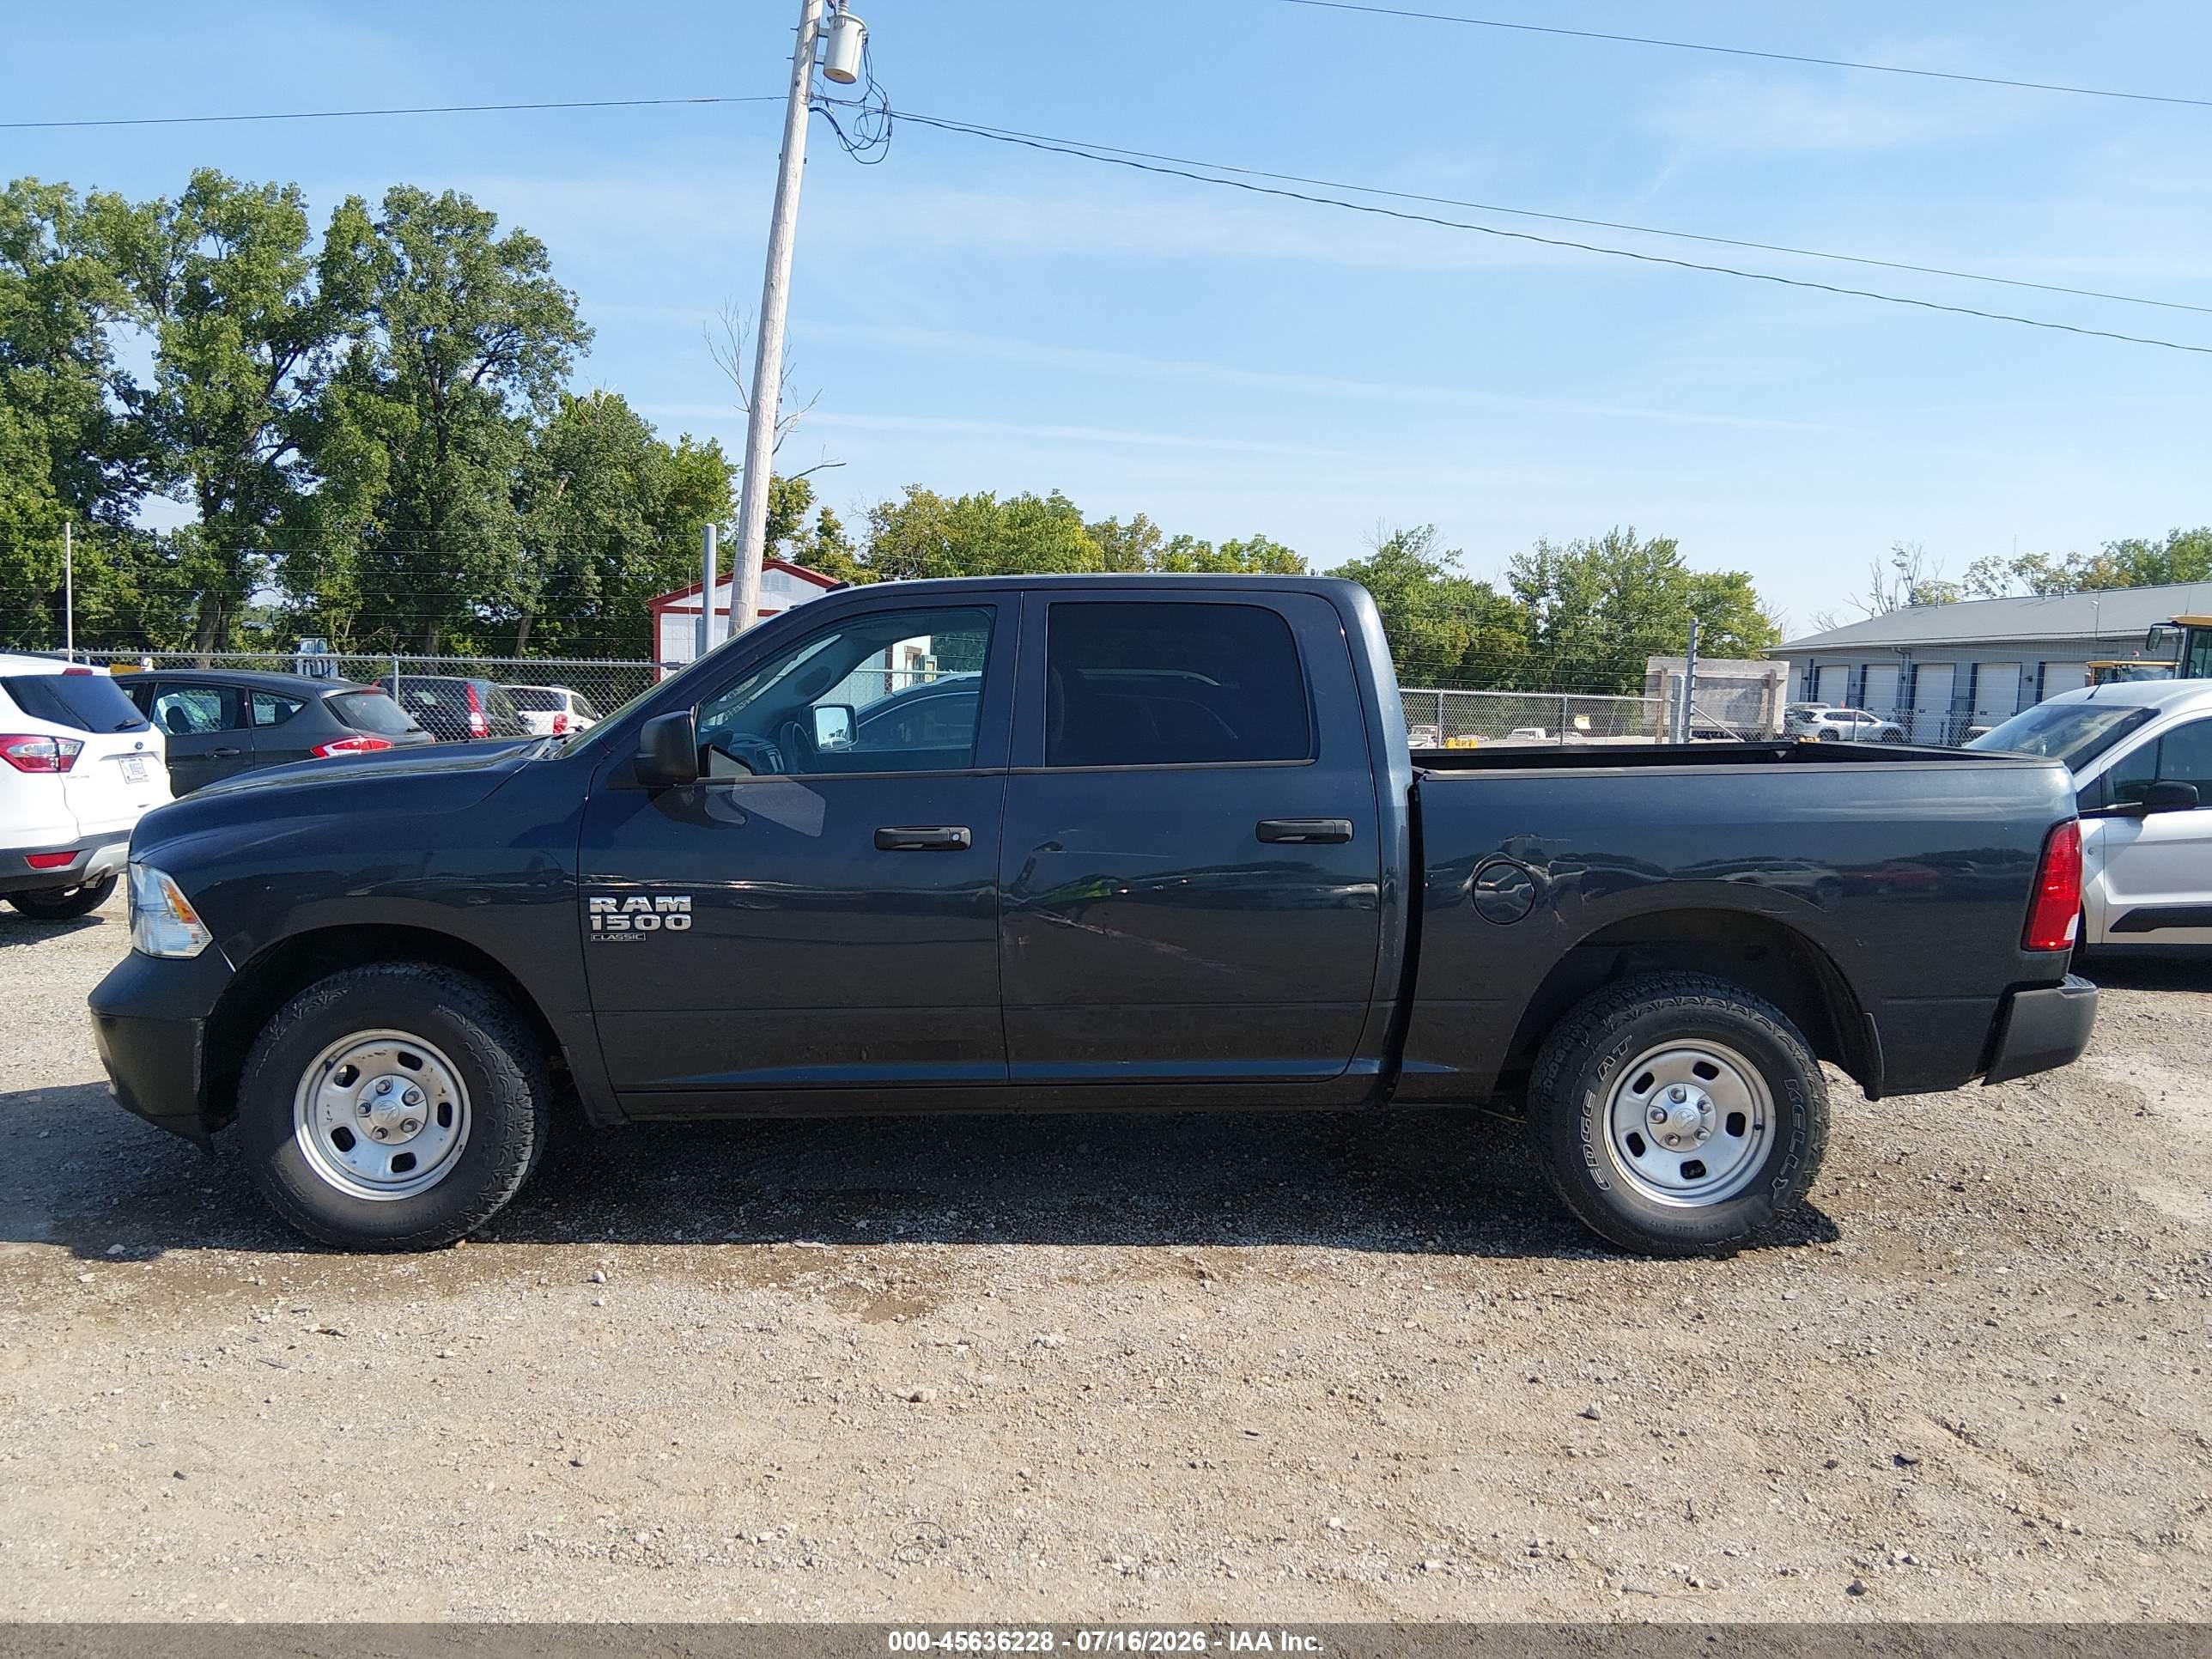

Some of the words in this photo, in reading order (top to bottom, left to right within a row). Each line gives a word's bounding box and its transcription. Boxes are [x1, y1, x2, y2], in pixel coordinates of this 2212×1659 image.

[589, 896, 692, 913] RAM
[589, 914, 692, 931] 1500
[1581, 1089, 1611, 1191] EDGE
[1597, 1035, 1632, 1081] AT
[1771, 1079, 1806, 1200] KELLY
